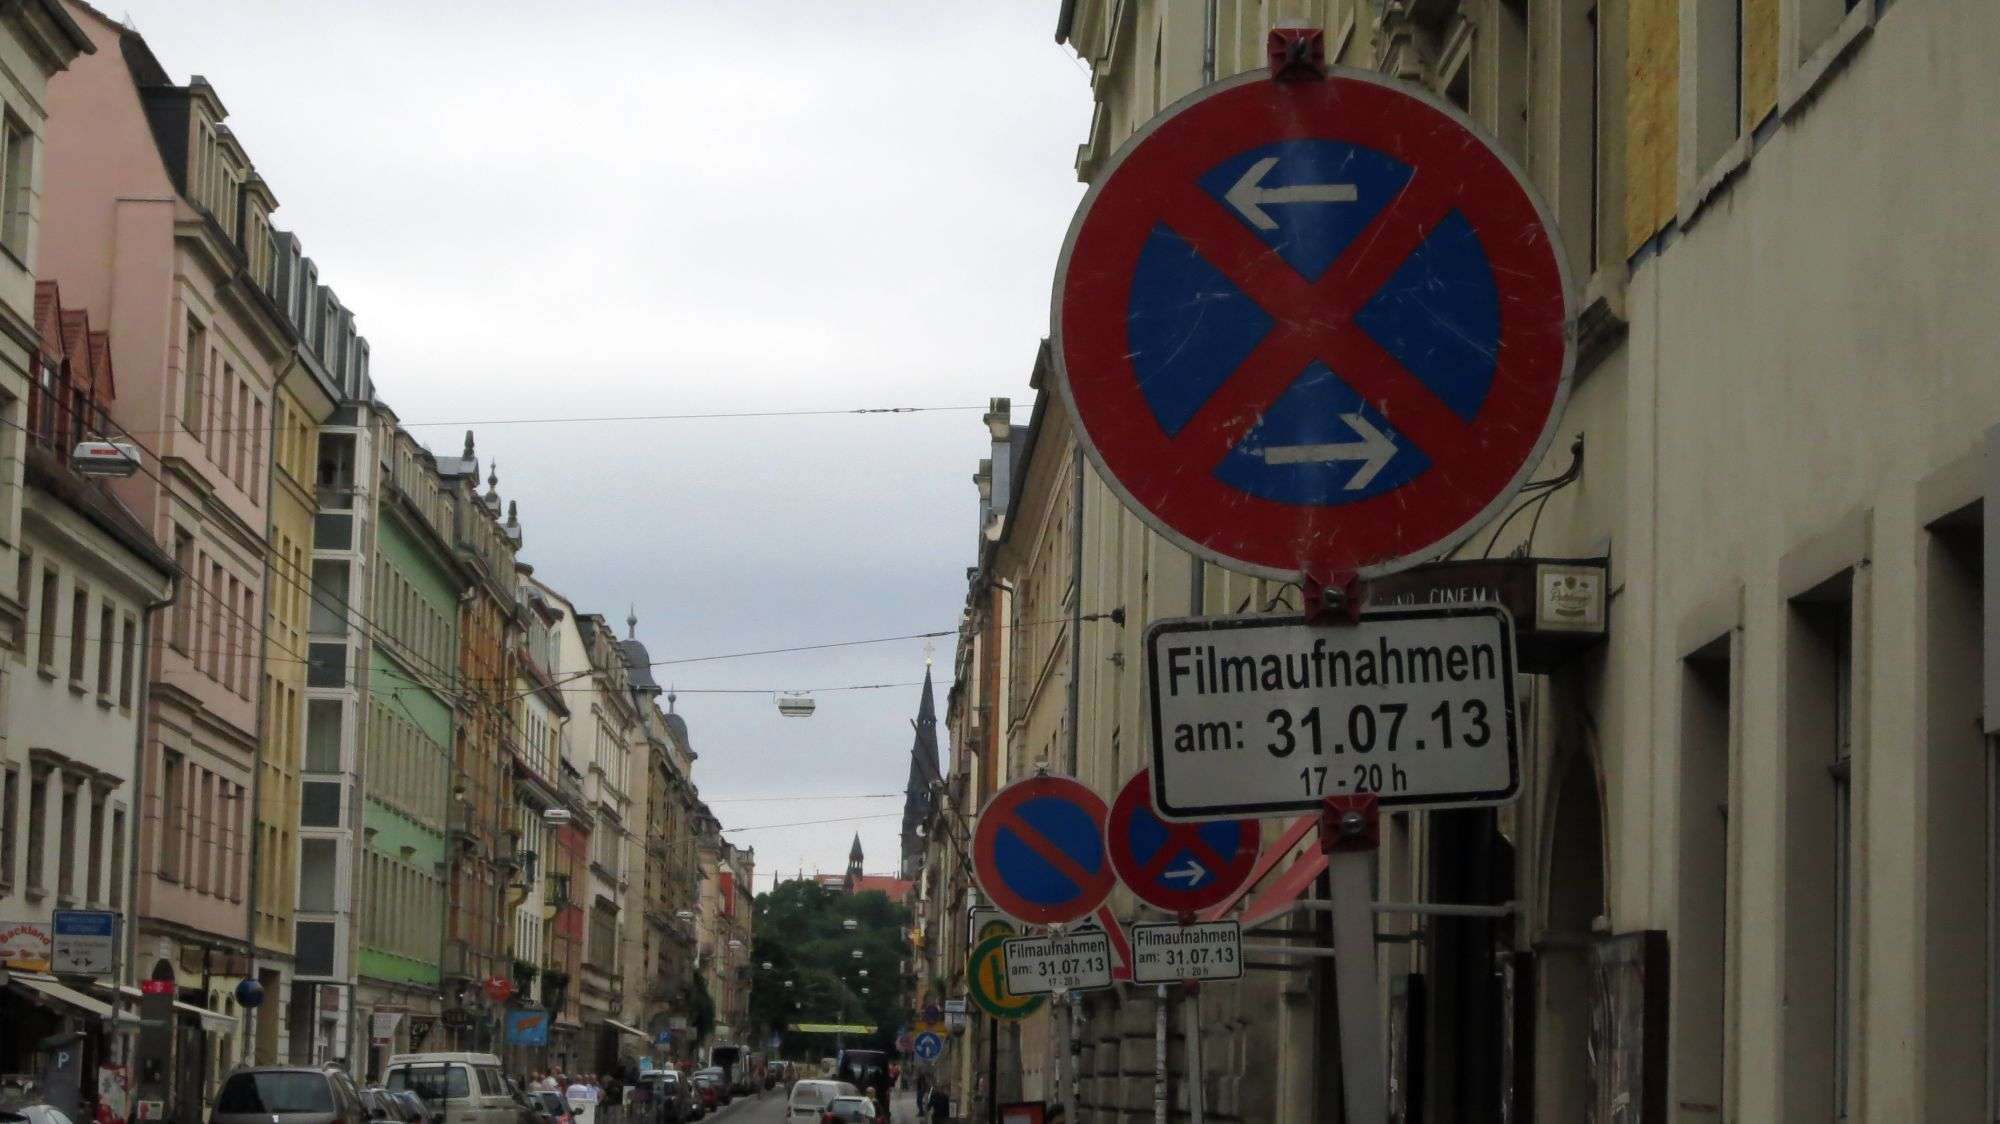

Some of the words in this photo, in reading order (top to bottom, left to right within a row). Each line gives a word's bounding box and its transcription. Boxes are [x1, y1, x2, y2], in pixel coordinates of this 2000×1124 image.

[1167, 636, 1496, 697] Filmaufnahmen
[1173, 720, 1244, 753] am:
[1265, 698, 1491, 758] 31.07.13
[1300, 766, 1327, 796] 17
[1353, 763, 1383, 793] 20
[1392, 762, 1407, 791] h
[1137, 928, 1236, 947] Filmaufnahmen
[1009, 938, 1106, 958] Filmaufnahmen
[1138, 952, 1160, 964] am:
[1166, 947, 1234, 965] 31.07.13
[1011, 964, 1032, 976] am:
[1038, 956, 1104, 976] 31.07.13
